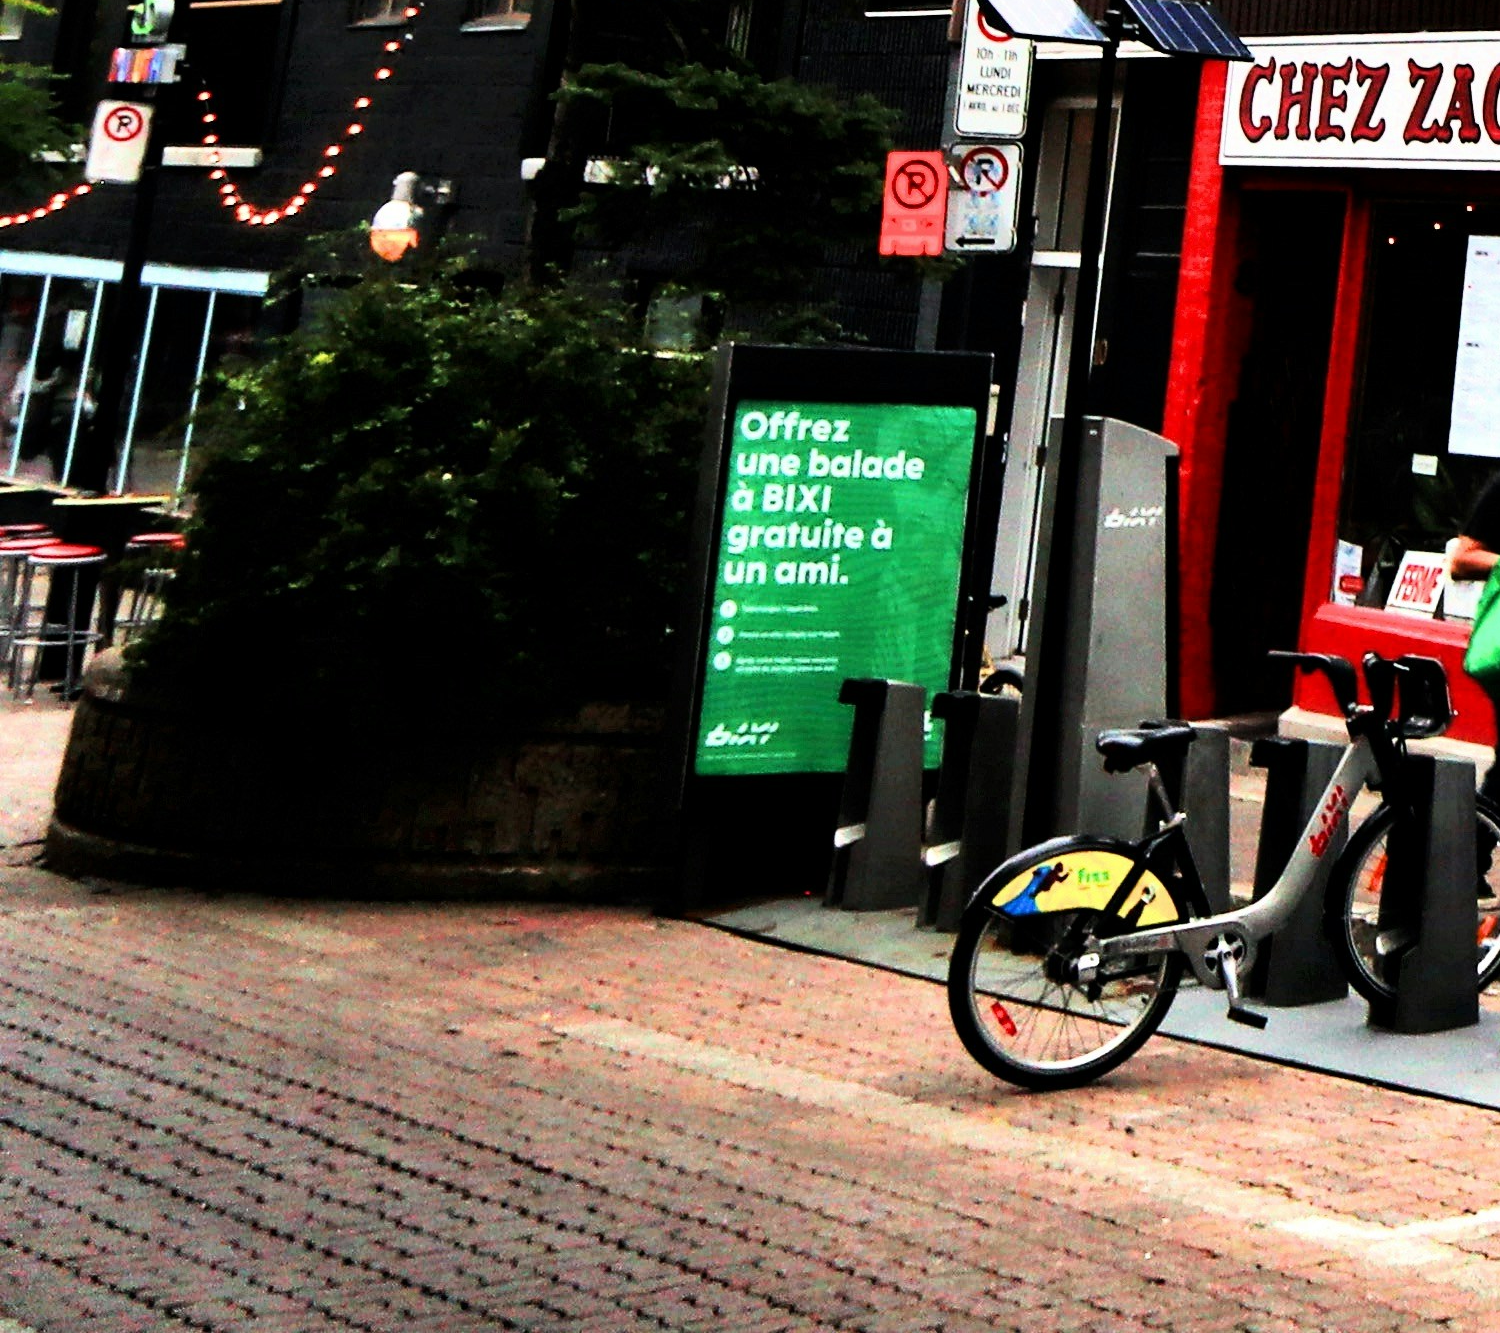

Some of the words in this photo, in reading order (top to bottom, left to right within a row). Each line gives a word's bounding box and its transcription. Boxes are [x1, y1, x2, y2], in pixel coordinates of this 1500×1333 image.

[980, 66, 1012, 79] LUNDI
[966, 84, 1021, 99] MERCREDI
[1239, 56, 1390, 143] CHEZ
[740, 411, 850, 442] Offrez
[737, 454, 799, 477] une
[809, 449, 925, 480] balade
[732, 484, 753, 512] à
[762, 485, 832, 512] BIXI
[727, 518, 864, 554] gratuite
[871, 520, 893, 548] à
[724, 561, 767, 584] un
[775, 556, 848, 585] ami.
